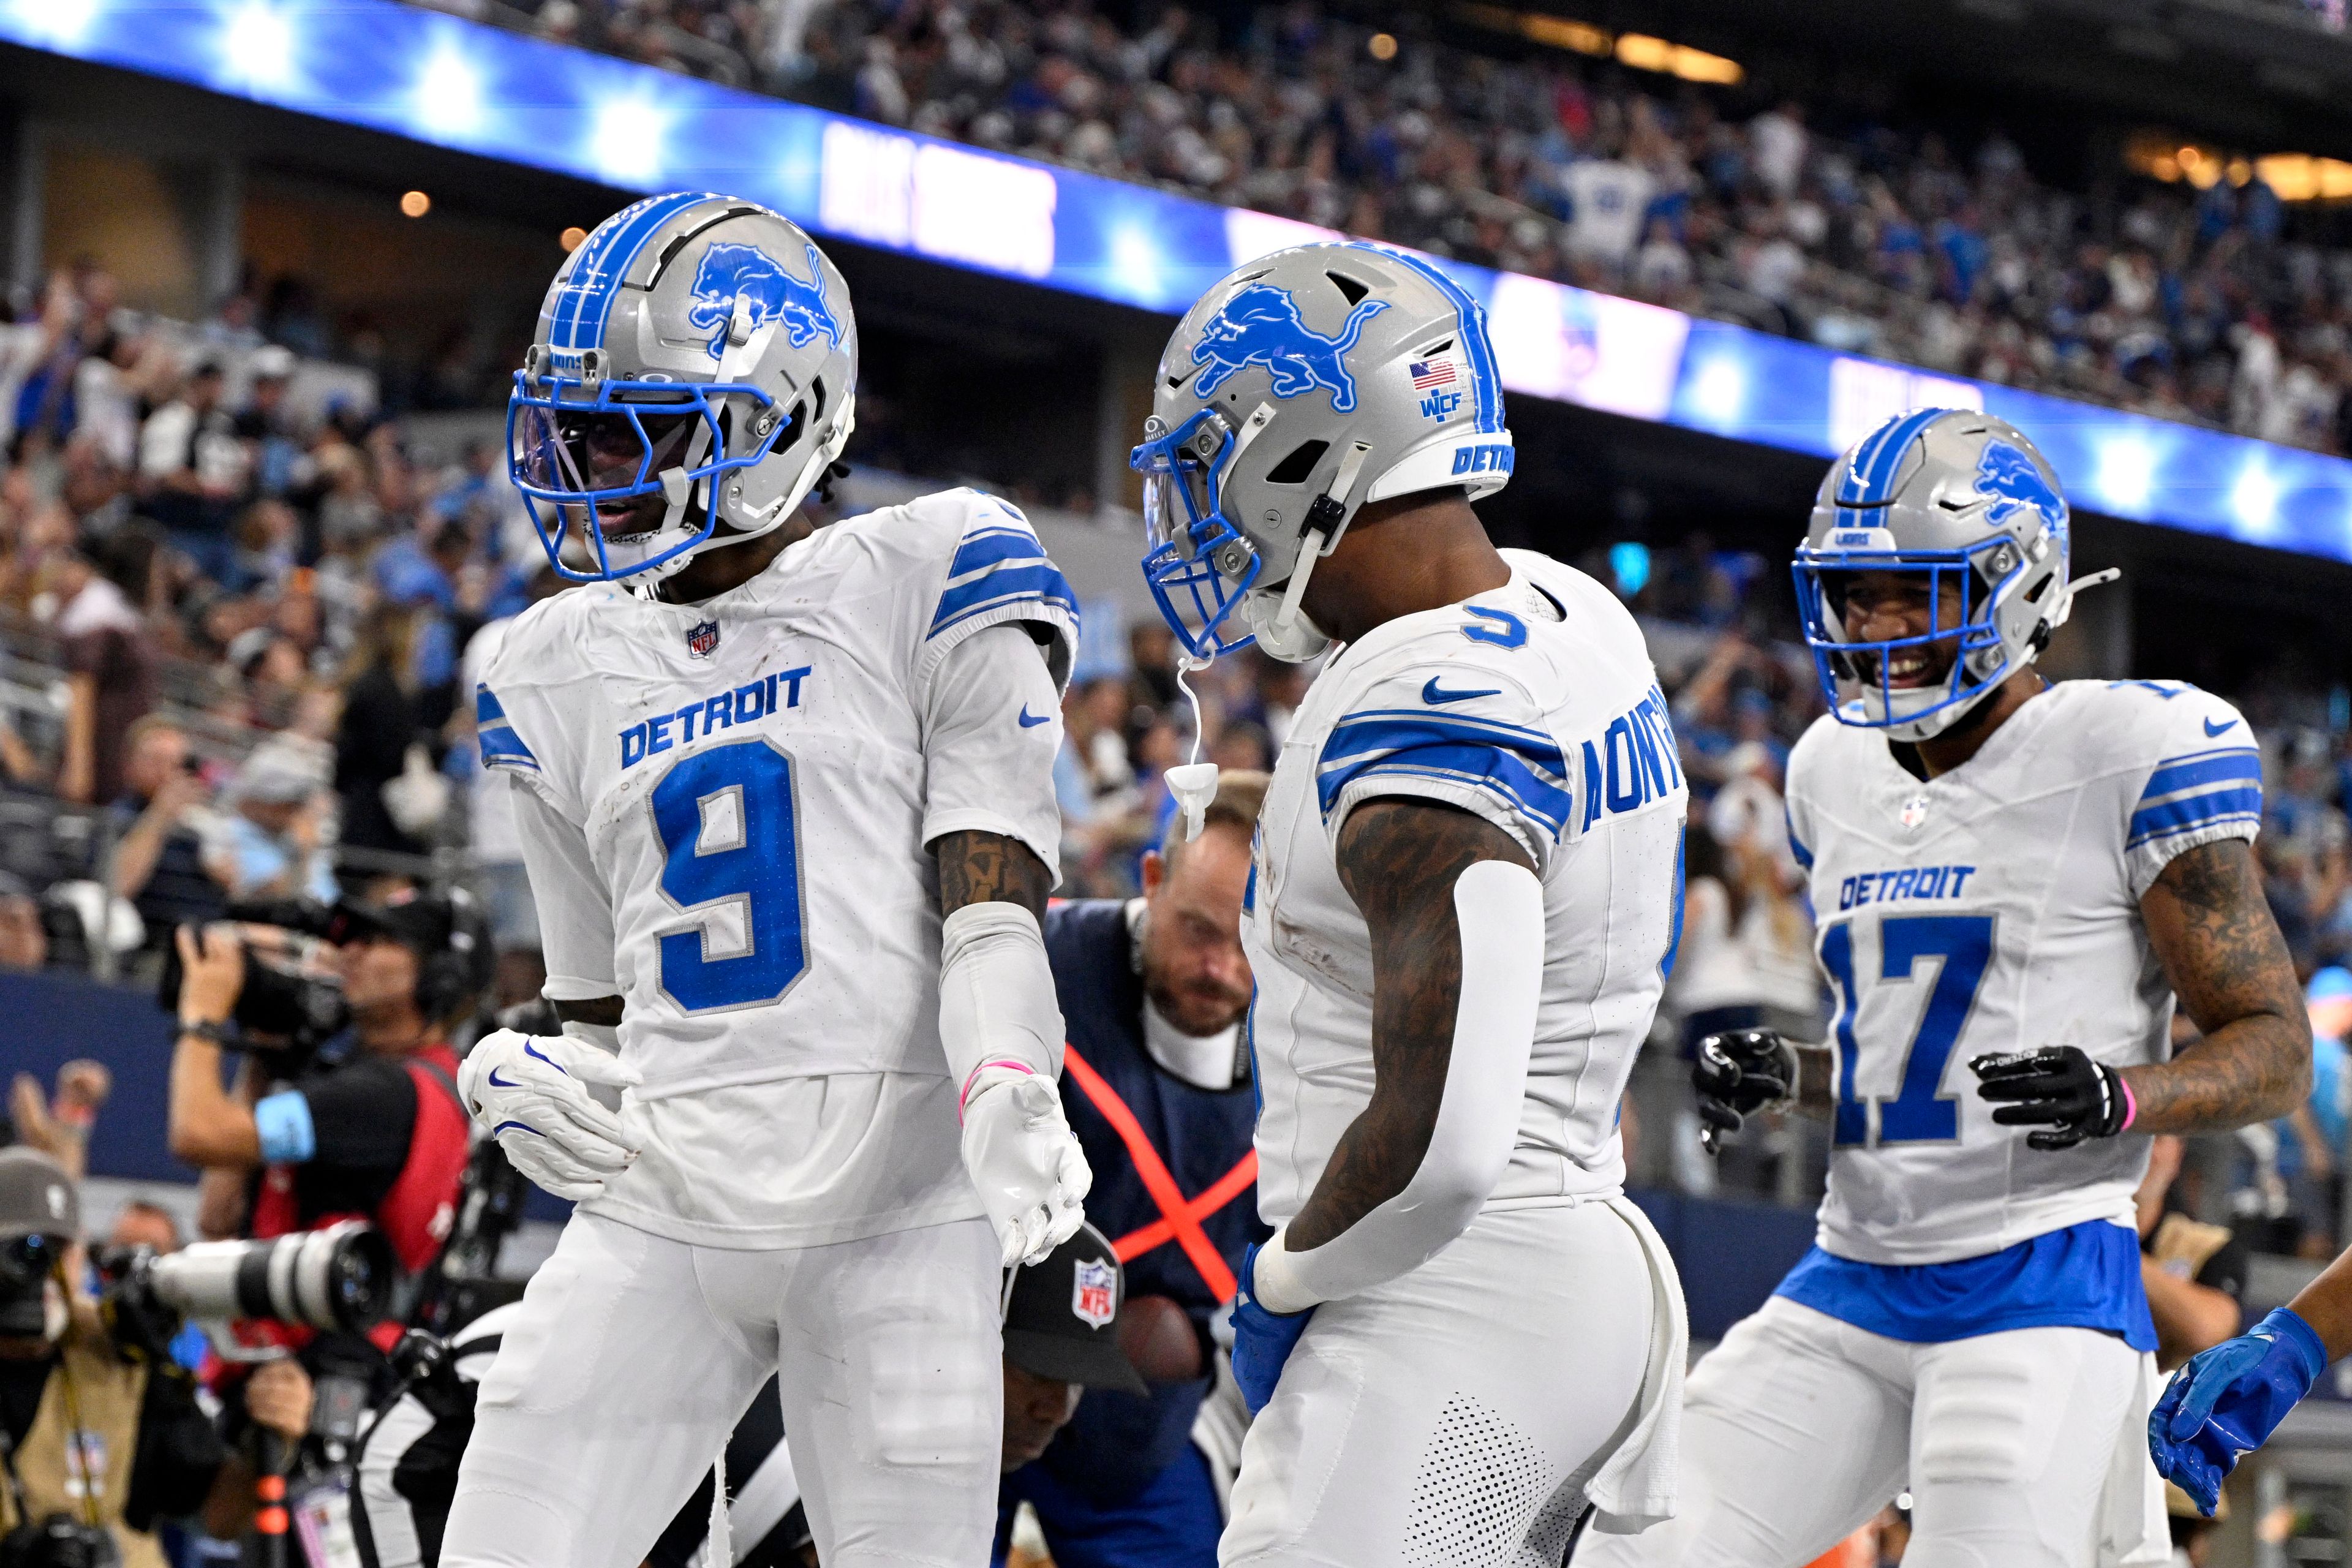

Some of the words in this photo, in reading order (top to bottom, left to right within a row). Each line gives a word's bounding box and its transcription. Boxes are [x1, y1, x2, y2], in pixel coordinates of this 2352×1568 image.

[1419, 391, 1462, 418] WCF
[691, 633, 716, 652] NFL
[619, 665, 812, 770] DETROIT
[646, 733, 812, 1019] 9
[1839, 865, 1977, 911] DETROIT
[1820, 910, 1999, 1150] 17
